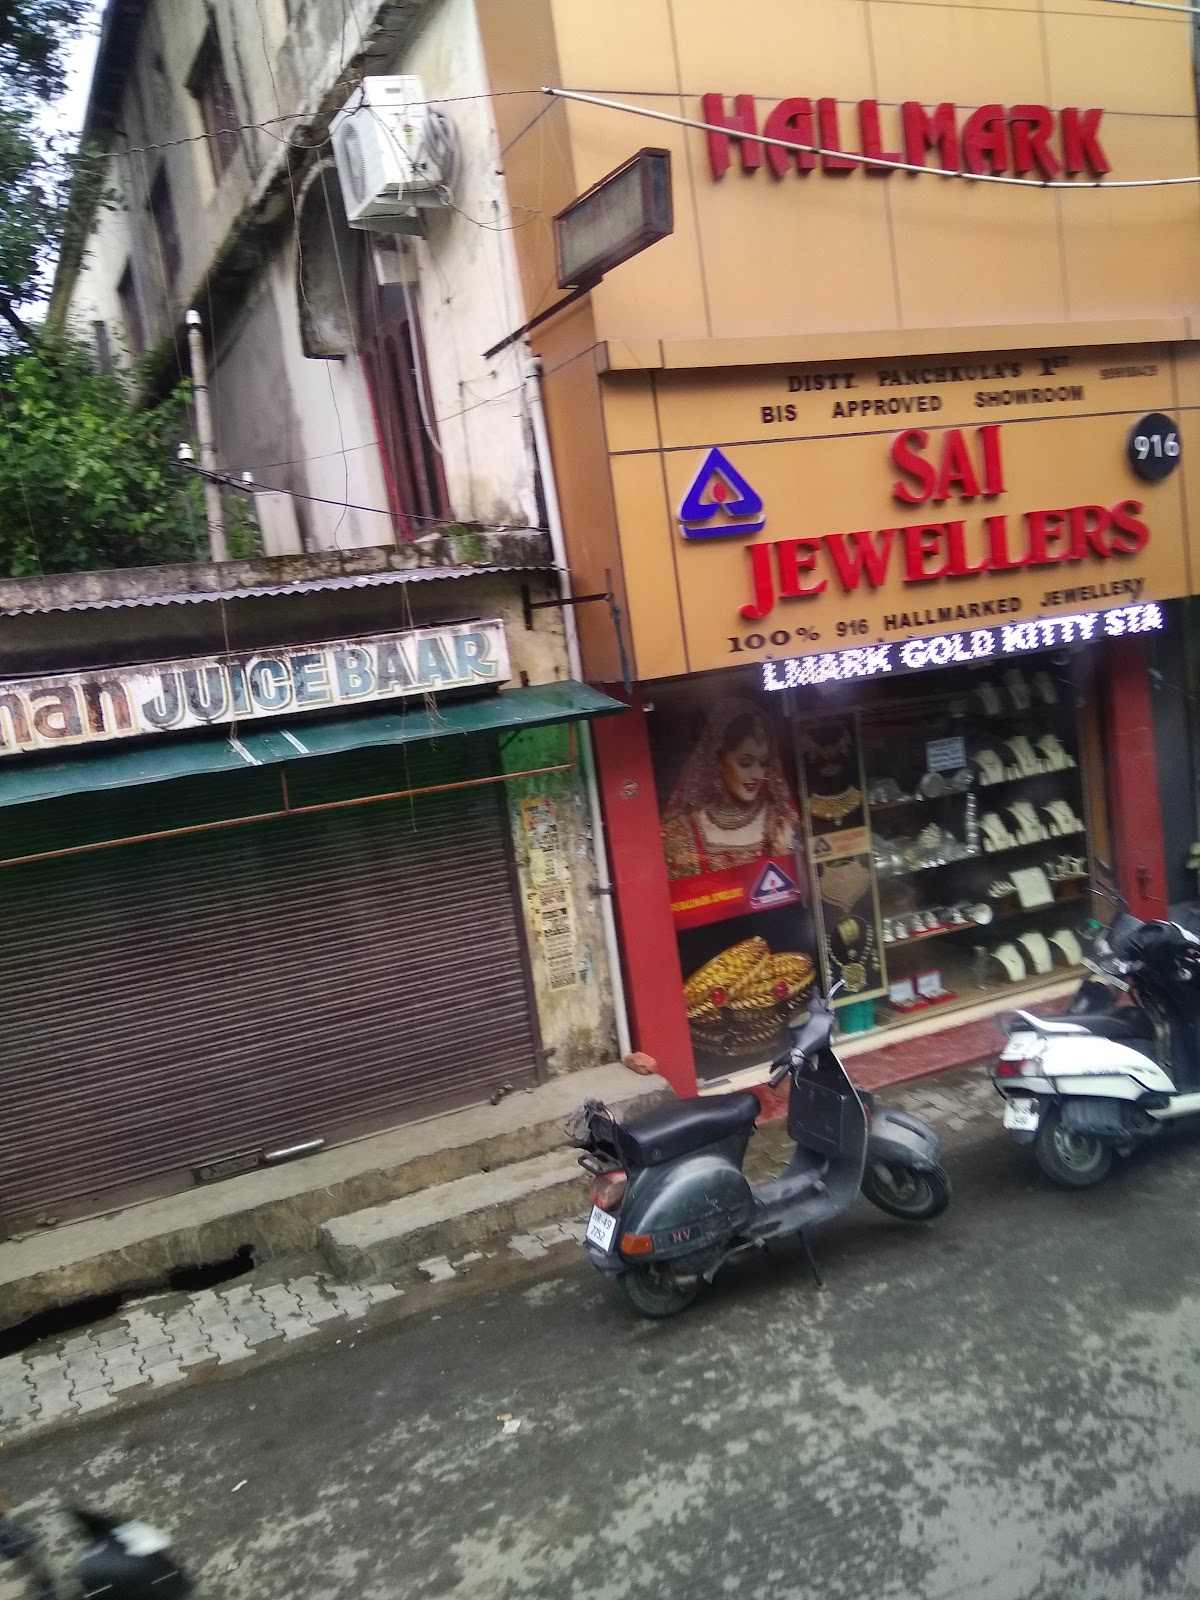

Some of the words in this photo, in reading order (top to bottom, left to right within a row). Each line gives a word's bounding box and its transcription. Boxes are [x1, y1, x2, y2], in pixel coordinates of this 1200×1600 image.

[701, 91, 1110, 181] HALLMARK
[760, 404, 798, 424] BIS
[832, 395, 943, 419] APPROVED
[974, 385, 1084, 408] SHOWROOM
[890, 424, 1009, 504] SAI
[1133, 432, 1180, 460] 916
[739, 500, 1150, 620] JEWELLERS
[835, 618, 869, 638] 916
[883, 596, 1022, 631] HALLMARKED
[1040, 577, 1146, 607] JEWELLERY
[899, 628, 996, 669] GOLD
[1001, 611, 1100, 653] KITTY
